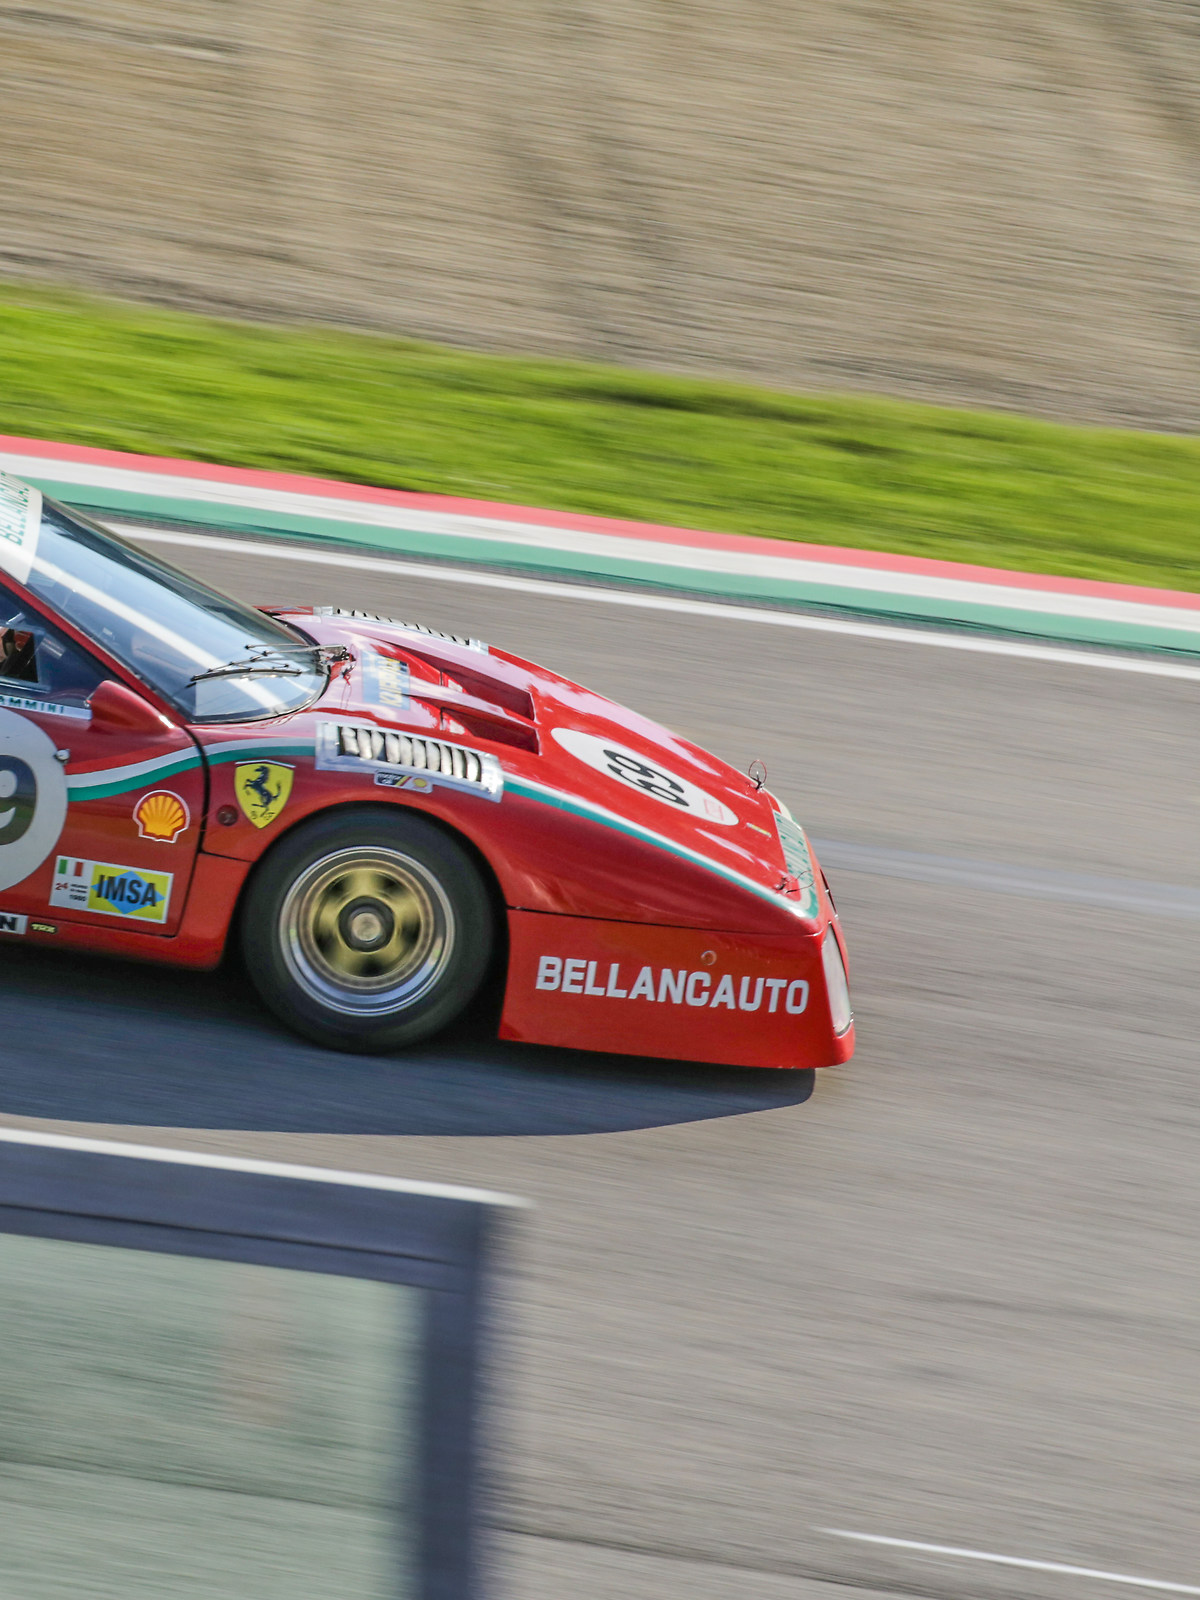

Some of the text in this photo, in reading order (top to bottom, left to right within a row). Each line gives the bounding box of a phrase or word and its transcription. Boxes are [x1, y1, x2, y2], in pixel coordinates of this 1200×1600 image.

[603, 749, 690, 806] 69
[96, 875, 156, 907] IMSA
[536, 955, 810, 1014] BELLANCAUTO
